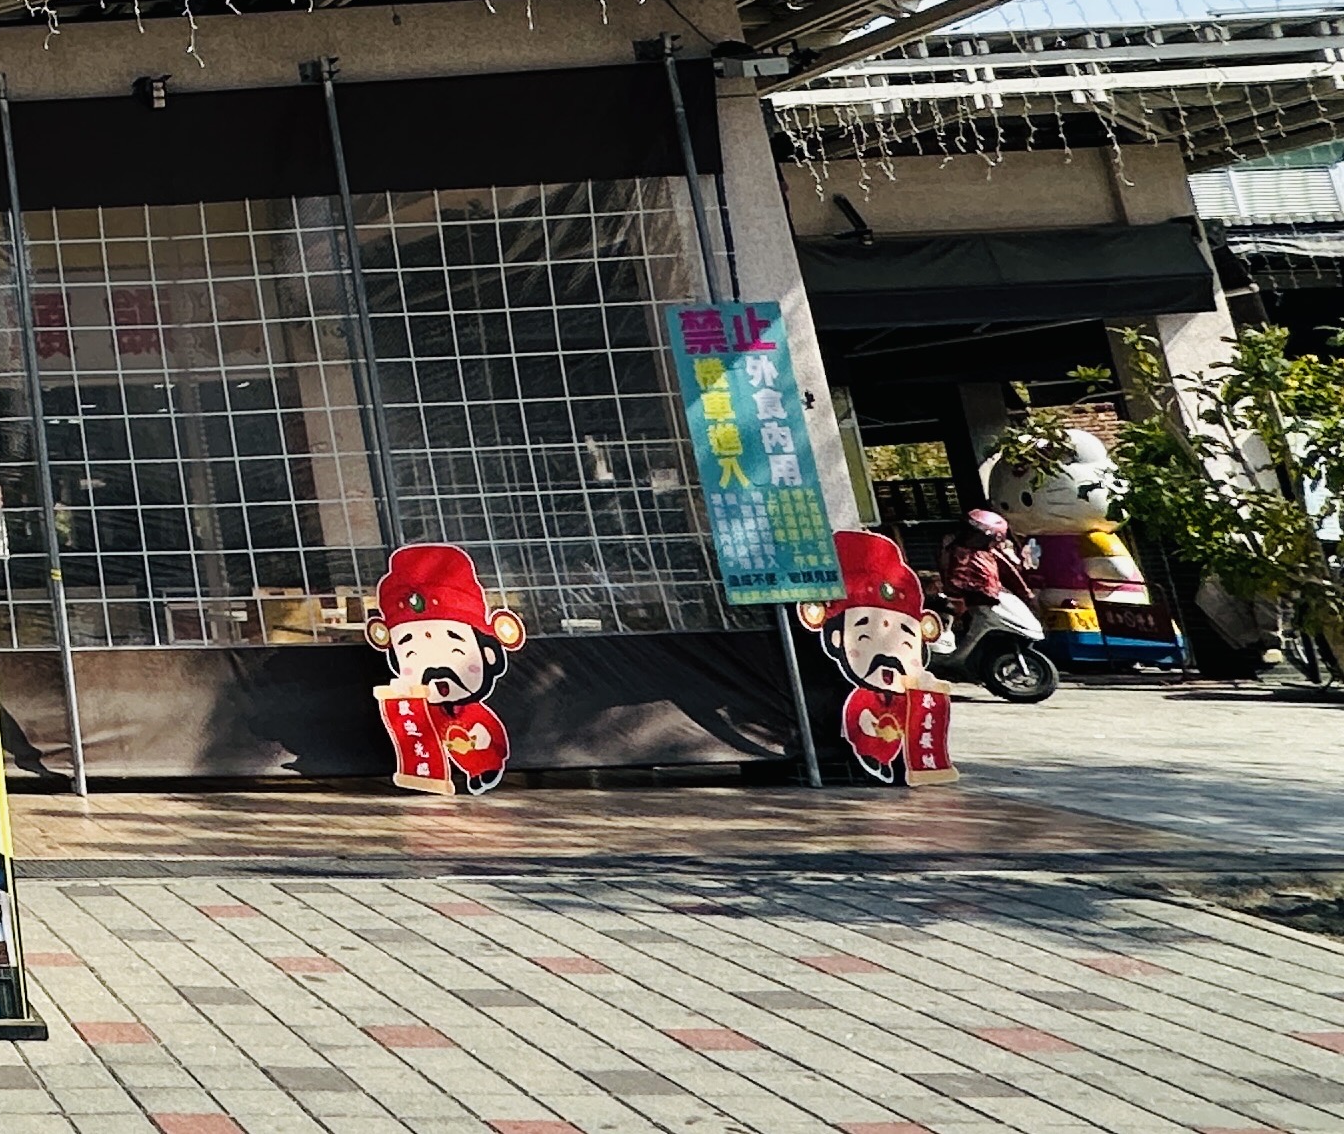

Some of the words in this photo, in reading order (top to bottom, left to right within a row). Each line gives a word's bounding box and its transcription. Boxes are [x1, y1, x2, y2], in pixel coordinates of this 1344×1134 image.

[678, 307, 777, 354] 禁止
[693, 357, 750, 489] 機車進入
[745, 355, 803, 487] 外食內用
